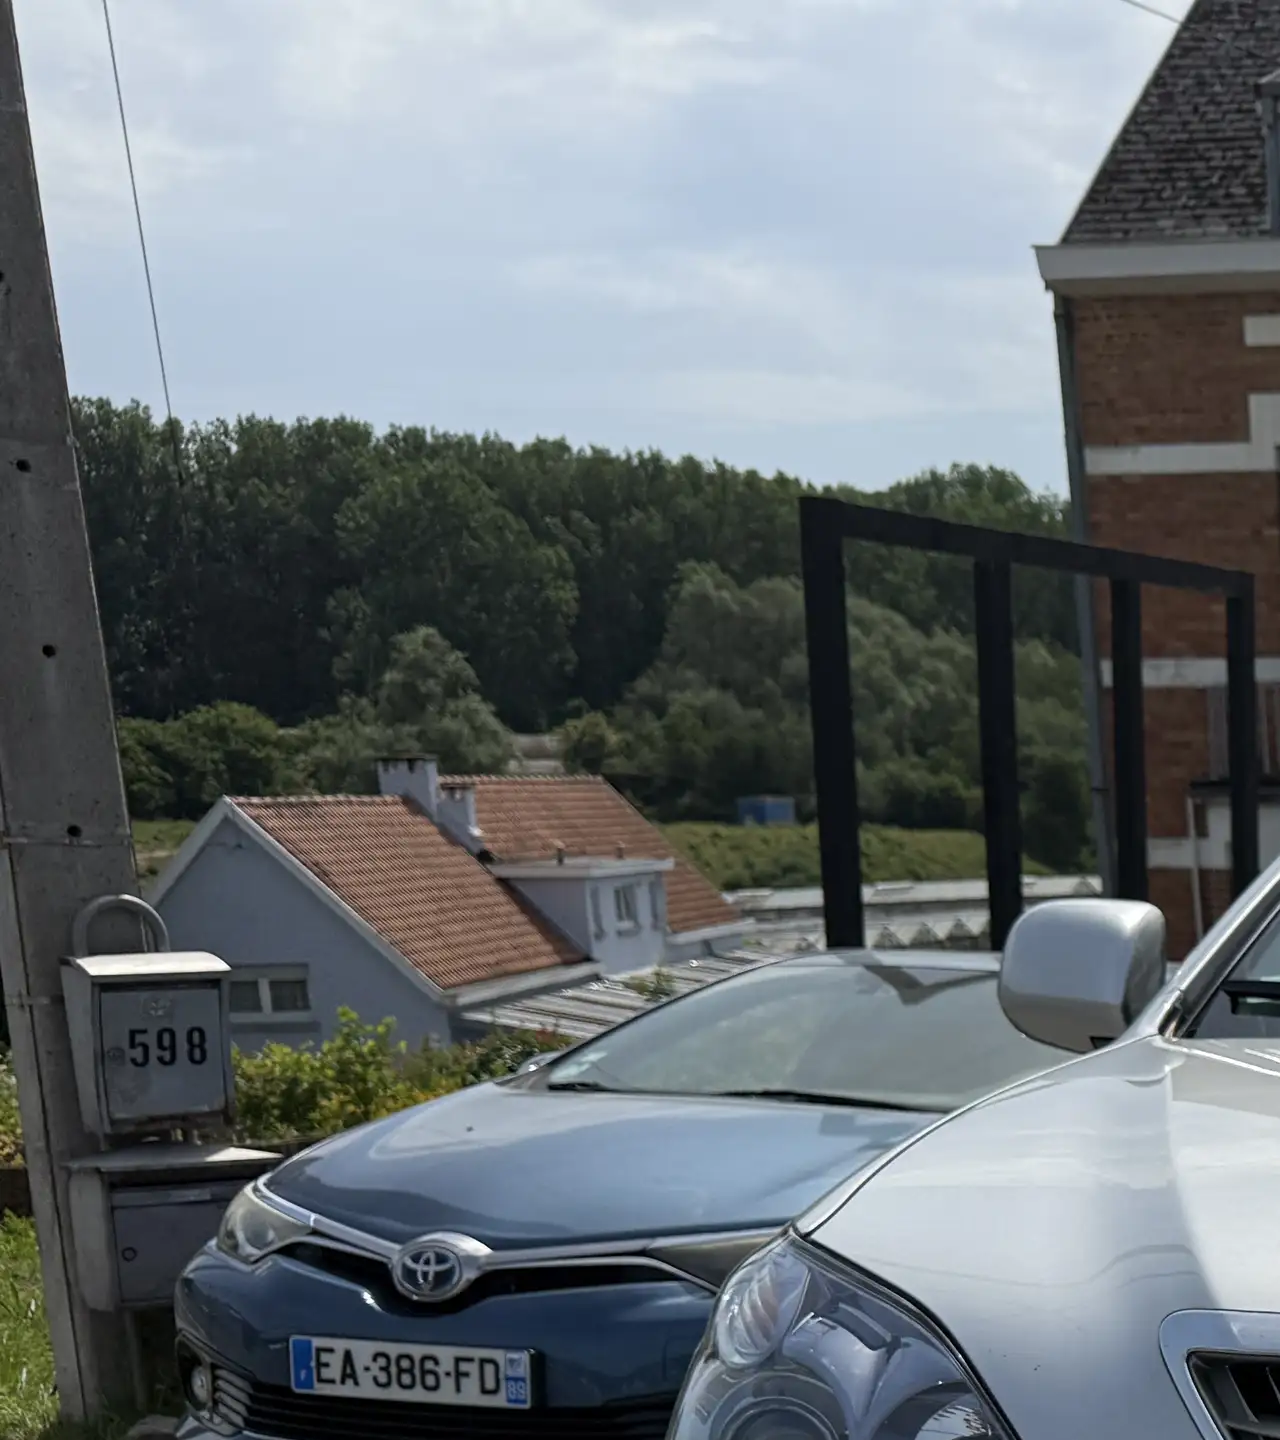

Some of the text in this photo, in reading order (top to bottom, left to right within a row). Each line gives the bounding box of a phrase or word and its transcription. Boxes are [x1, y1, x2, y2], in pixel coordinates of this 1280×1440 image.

[128, 1026, 208, 1067] 598
[315, 1346, 500, 1395] EA-386-FD
[508, 1380, 526, 1400] 89
